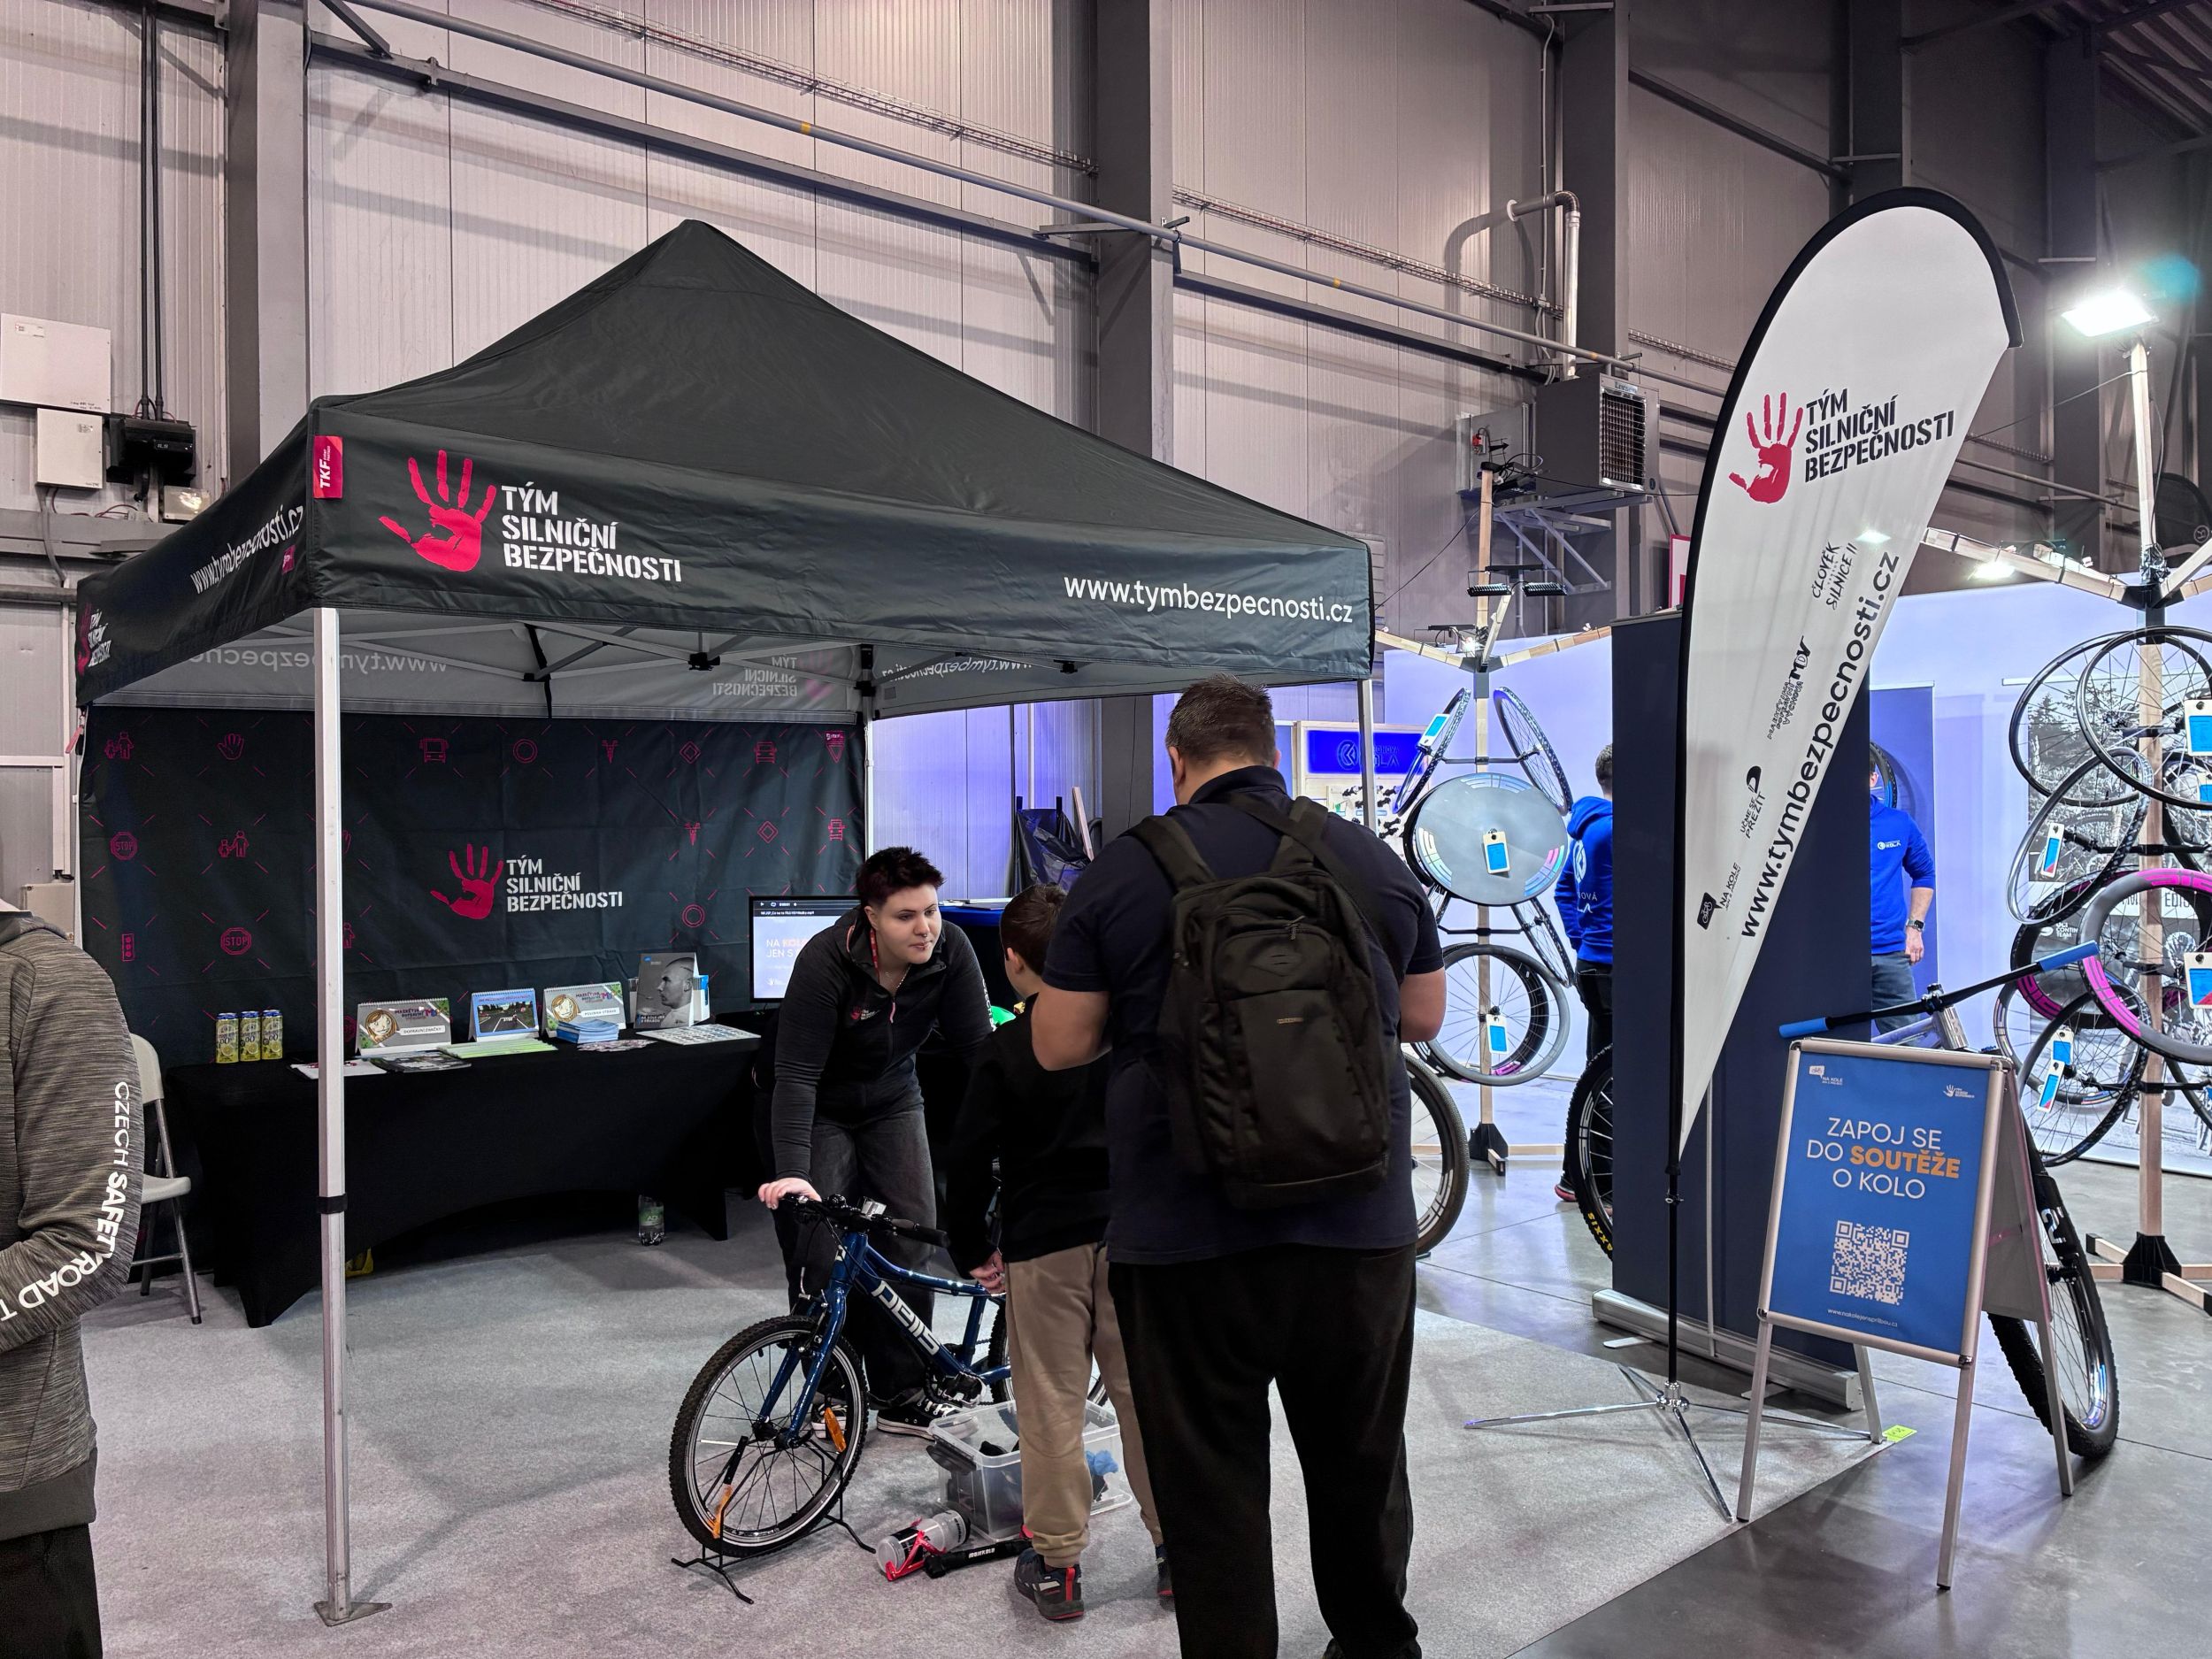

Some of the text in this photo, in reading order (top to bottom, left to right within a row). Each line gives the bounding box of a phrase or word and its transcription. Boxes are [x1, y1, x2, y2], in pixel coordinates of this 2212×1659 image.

[1807, 388, 1847, 422] TÝM
[1805, 395, 1899, 454] SILNIČNÍ
[1804, 410, 1955, 483] BEZPEČNOSTI
[319, 458, 331, 488] TKF
[502, 481, 558, 516] TÝM
[502, 515, 618, 549] SILNIČNÍ
[503, 542, 682, 582] BEZPEČNOSTI
[1811, 541, 1841, 598] ČLOVĚK
[1064, 576, 1354, 625] www.tymbezpecnosti.cz
[1741, 550, 1900, 939] www.tymbezpecnosti.cz
[116, 841, 134, 850] STOP
[506, 855, 542, 875] TÝM
[506, 872, 581, 894] SILNIČNÍ
[1719, 862, 1739, 907] NA KOLE
[507, 891, 623, 912] BEZPEČNOSTI
[225, 936, 248, 946] STOP
[767, 949, 785, 957] JEN
[113, 1081, 130, 1167] CZECH
[1827, 1117, 1942, 1150] ZAPOJ SE
[1807, 1139, 1961, 1179] DO SOUTĚŽE
[1832, 1168, 1925, 1200] O KOLO
[96, 1171, 129, 1267] SAFETY
[19, 1249, 98, 1309] ROAD
